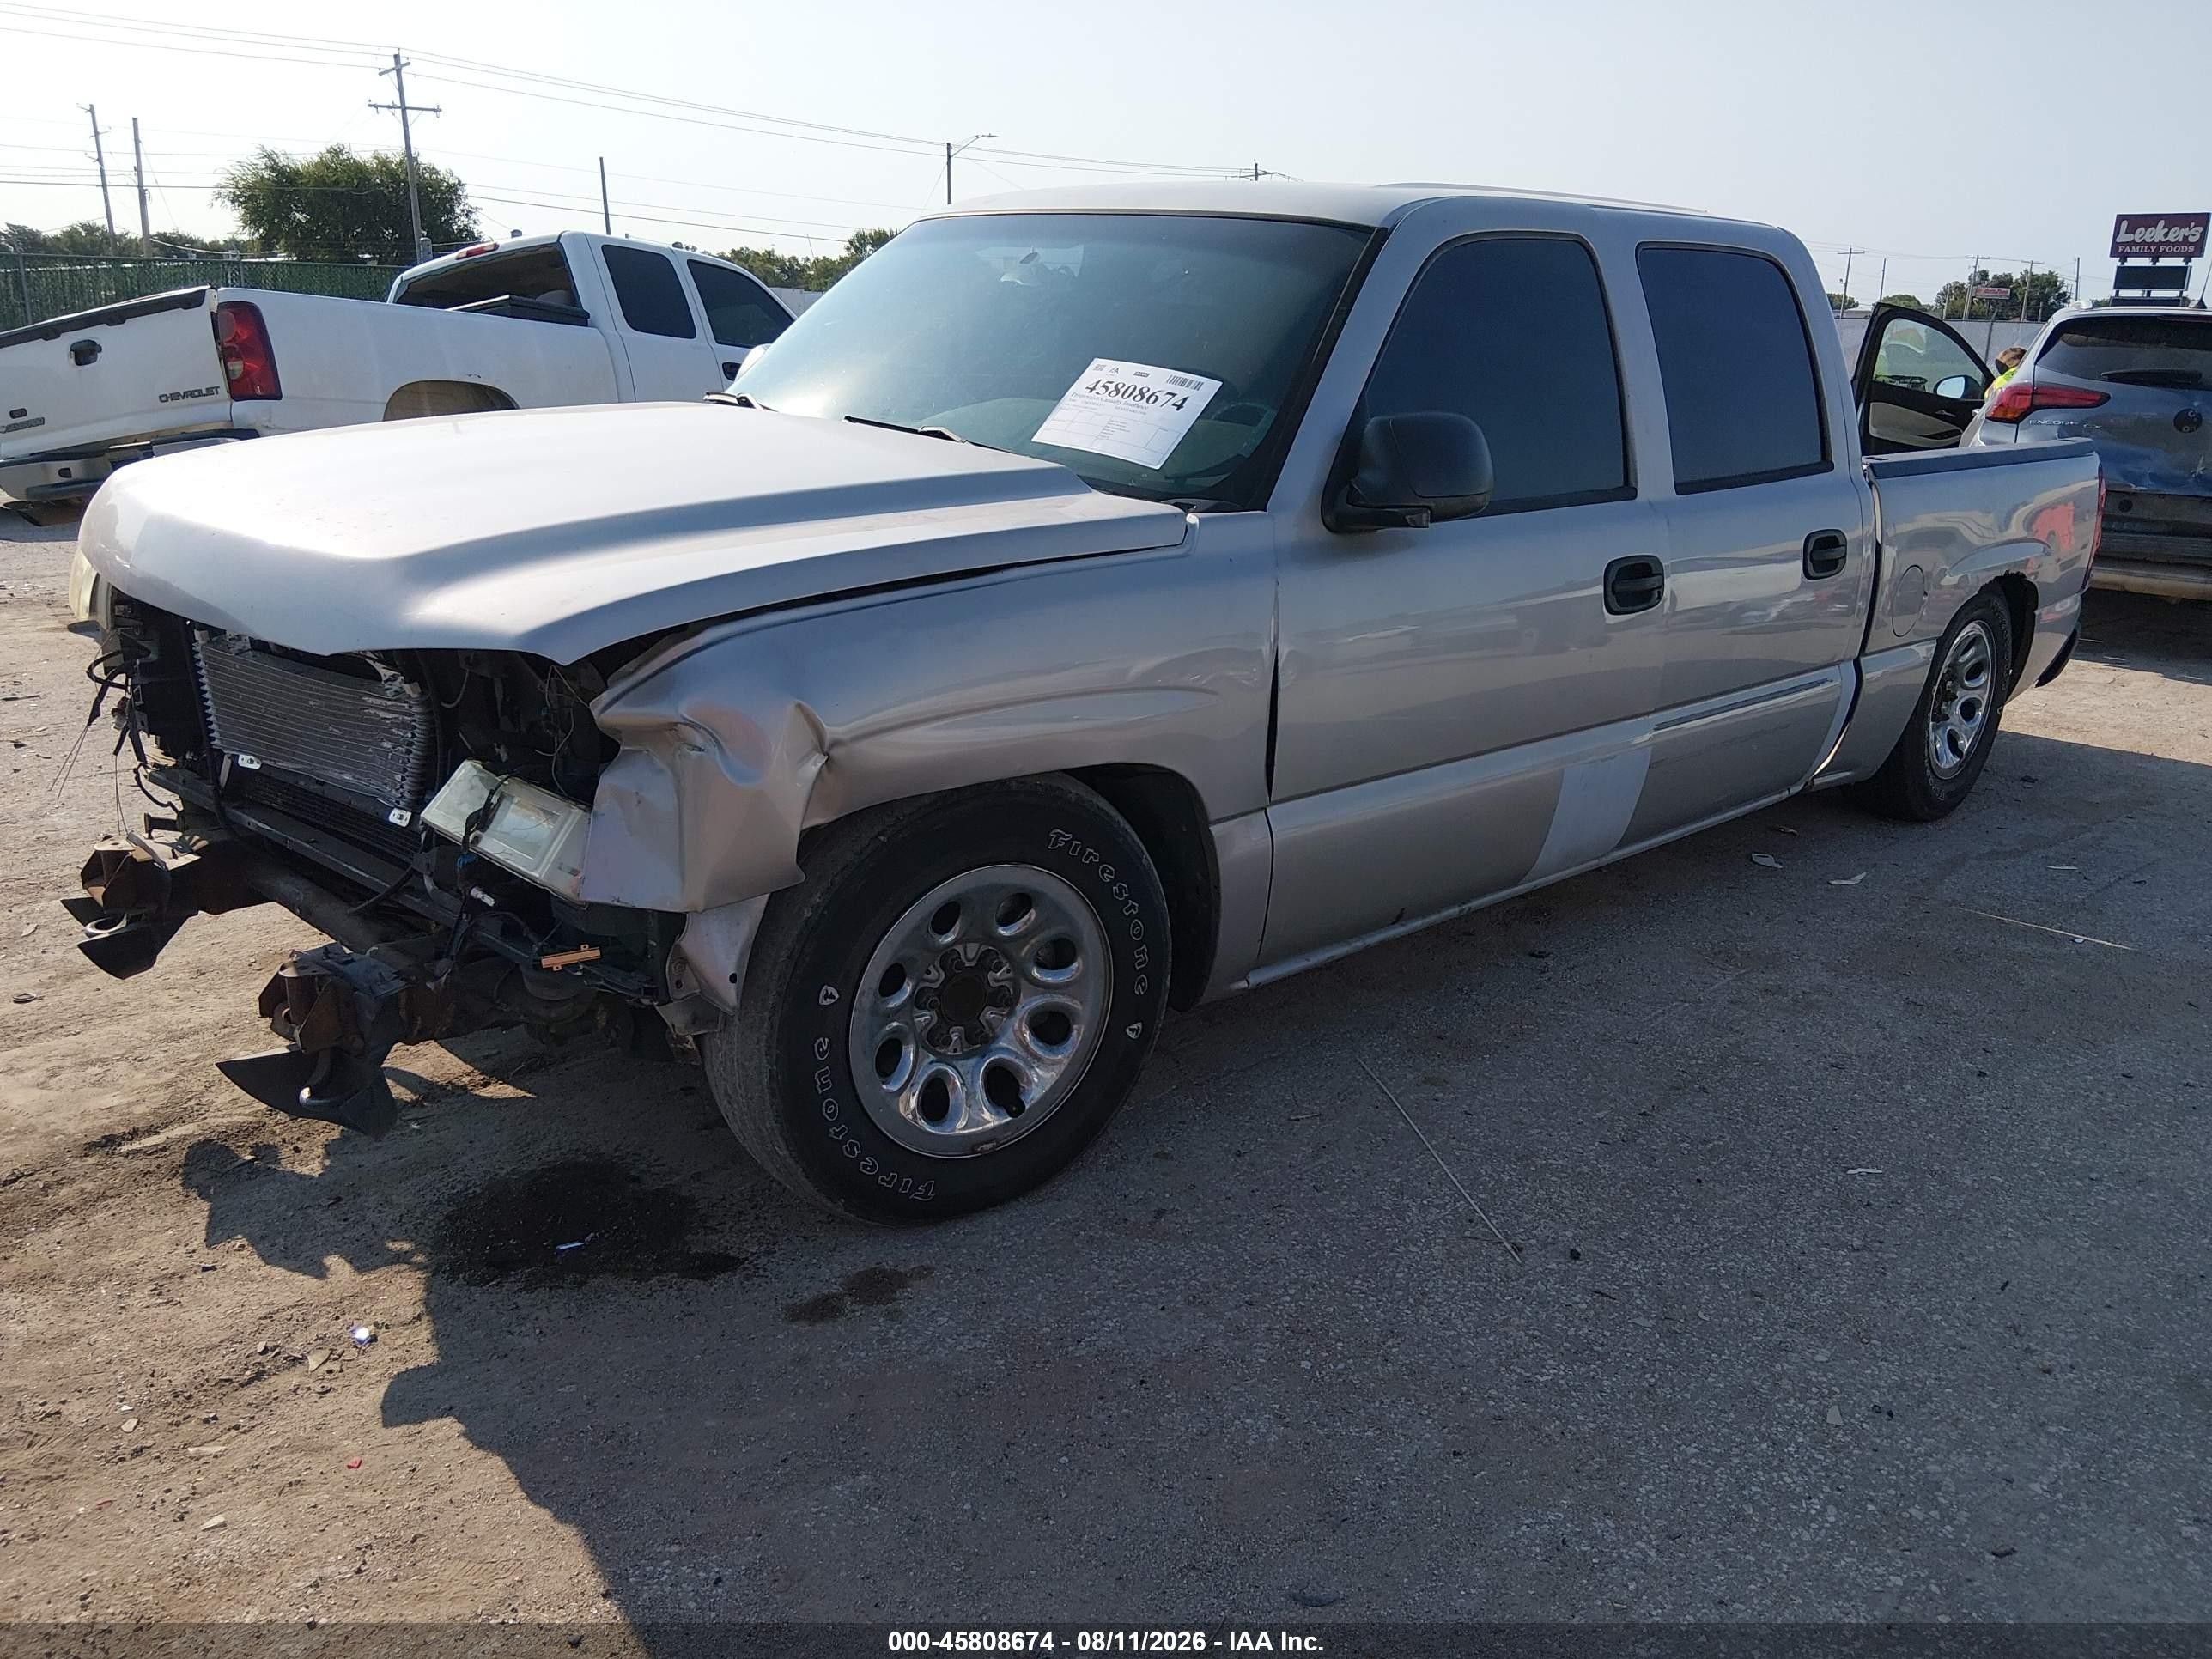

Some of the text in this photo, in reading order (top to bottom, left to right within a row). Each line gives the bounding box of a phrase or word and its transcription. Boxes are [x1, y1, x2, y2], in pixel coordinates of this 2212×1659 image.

[2116, 219, 2203, 242] Leeker's
[159, 386, 221, 403] CHEVROLET
[1085, 379, 1190, 412] 45808674
[1048, 828, 1149, 997] Firestone
[812, 1036, 937, 1202] Firestone
